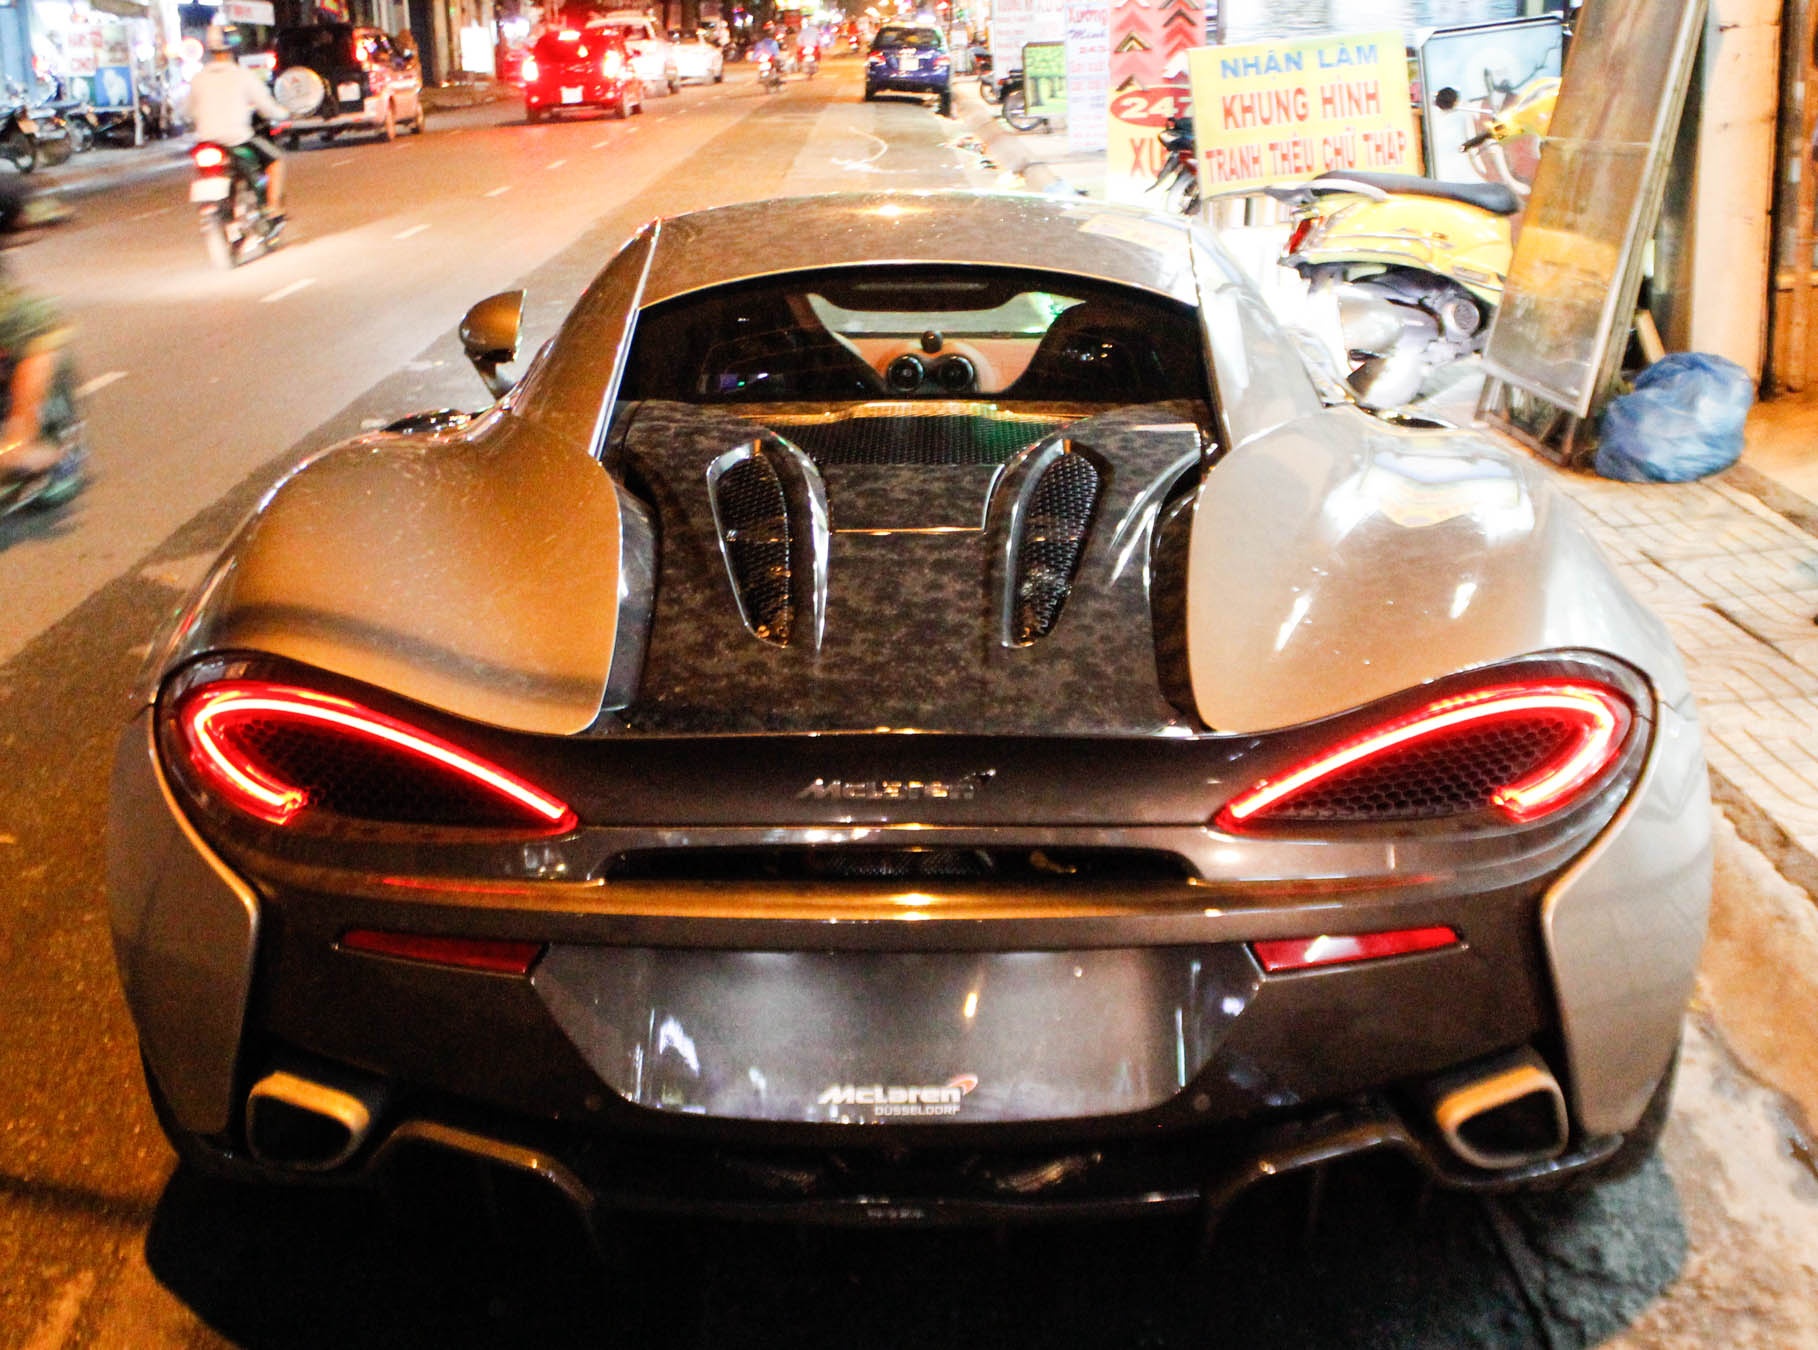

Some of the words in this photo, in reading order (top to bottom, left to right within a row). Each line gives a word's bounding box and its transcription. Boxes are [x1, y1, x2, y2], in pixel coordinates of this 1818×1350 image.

[1220, 50, 1304, 80] NHẬN
[1317, 43, 1378, 68] LÀM
[1222, 87, 1310, 130] KHUNG
[1320, 76, 1382, 119] HÌNH
[1205, 144, 1264, 184] TRANH
[818, 1085, 961, 1104] McLaren
